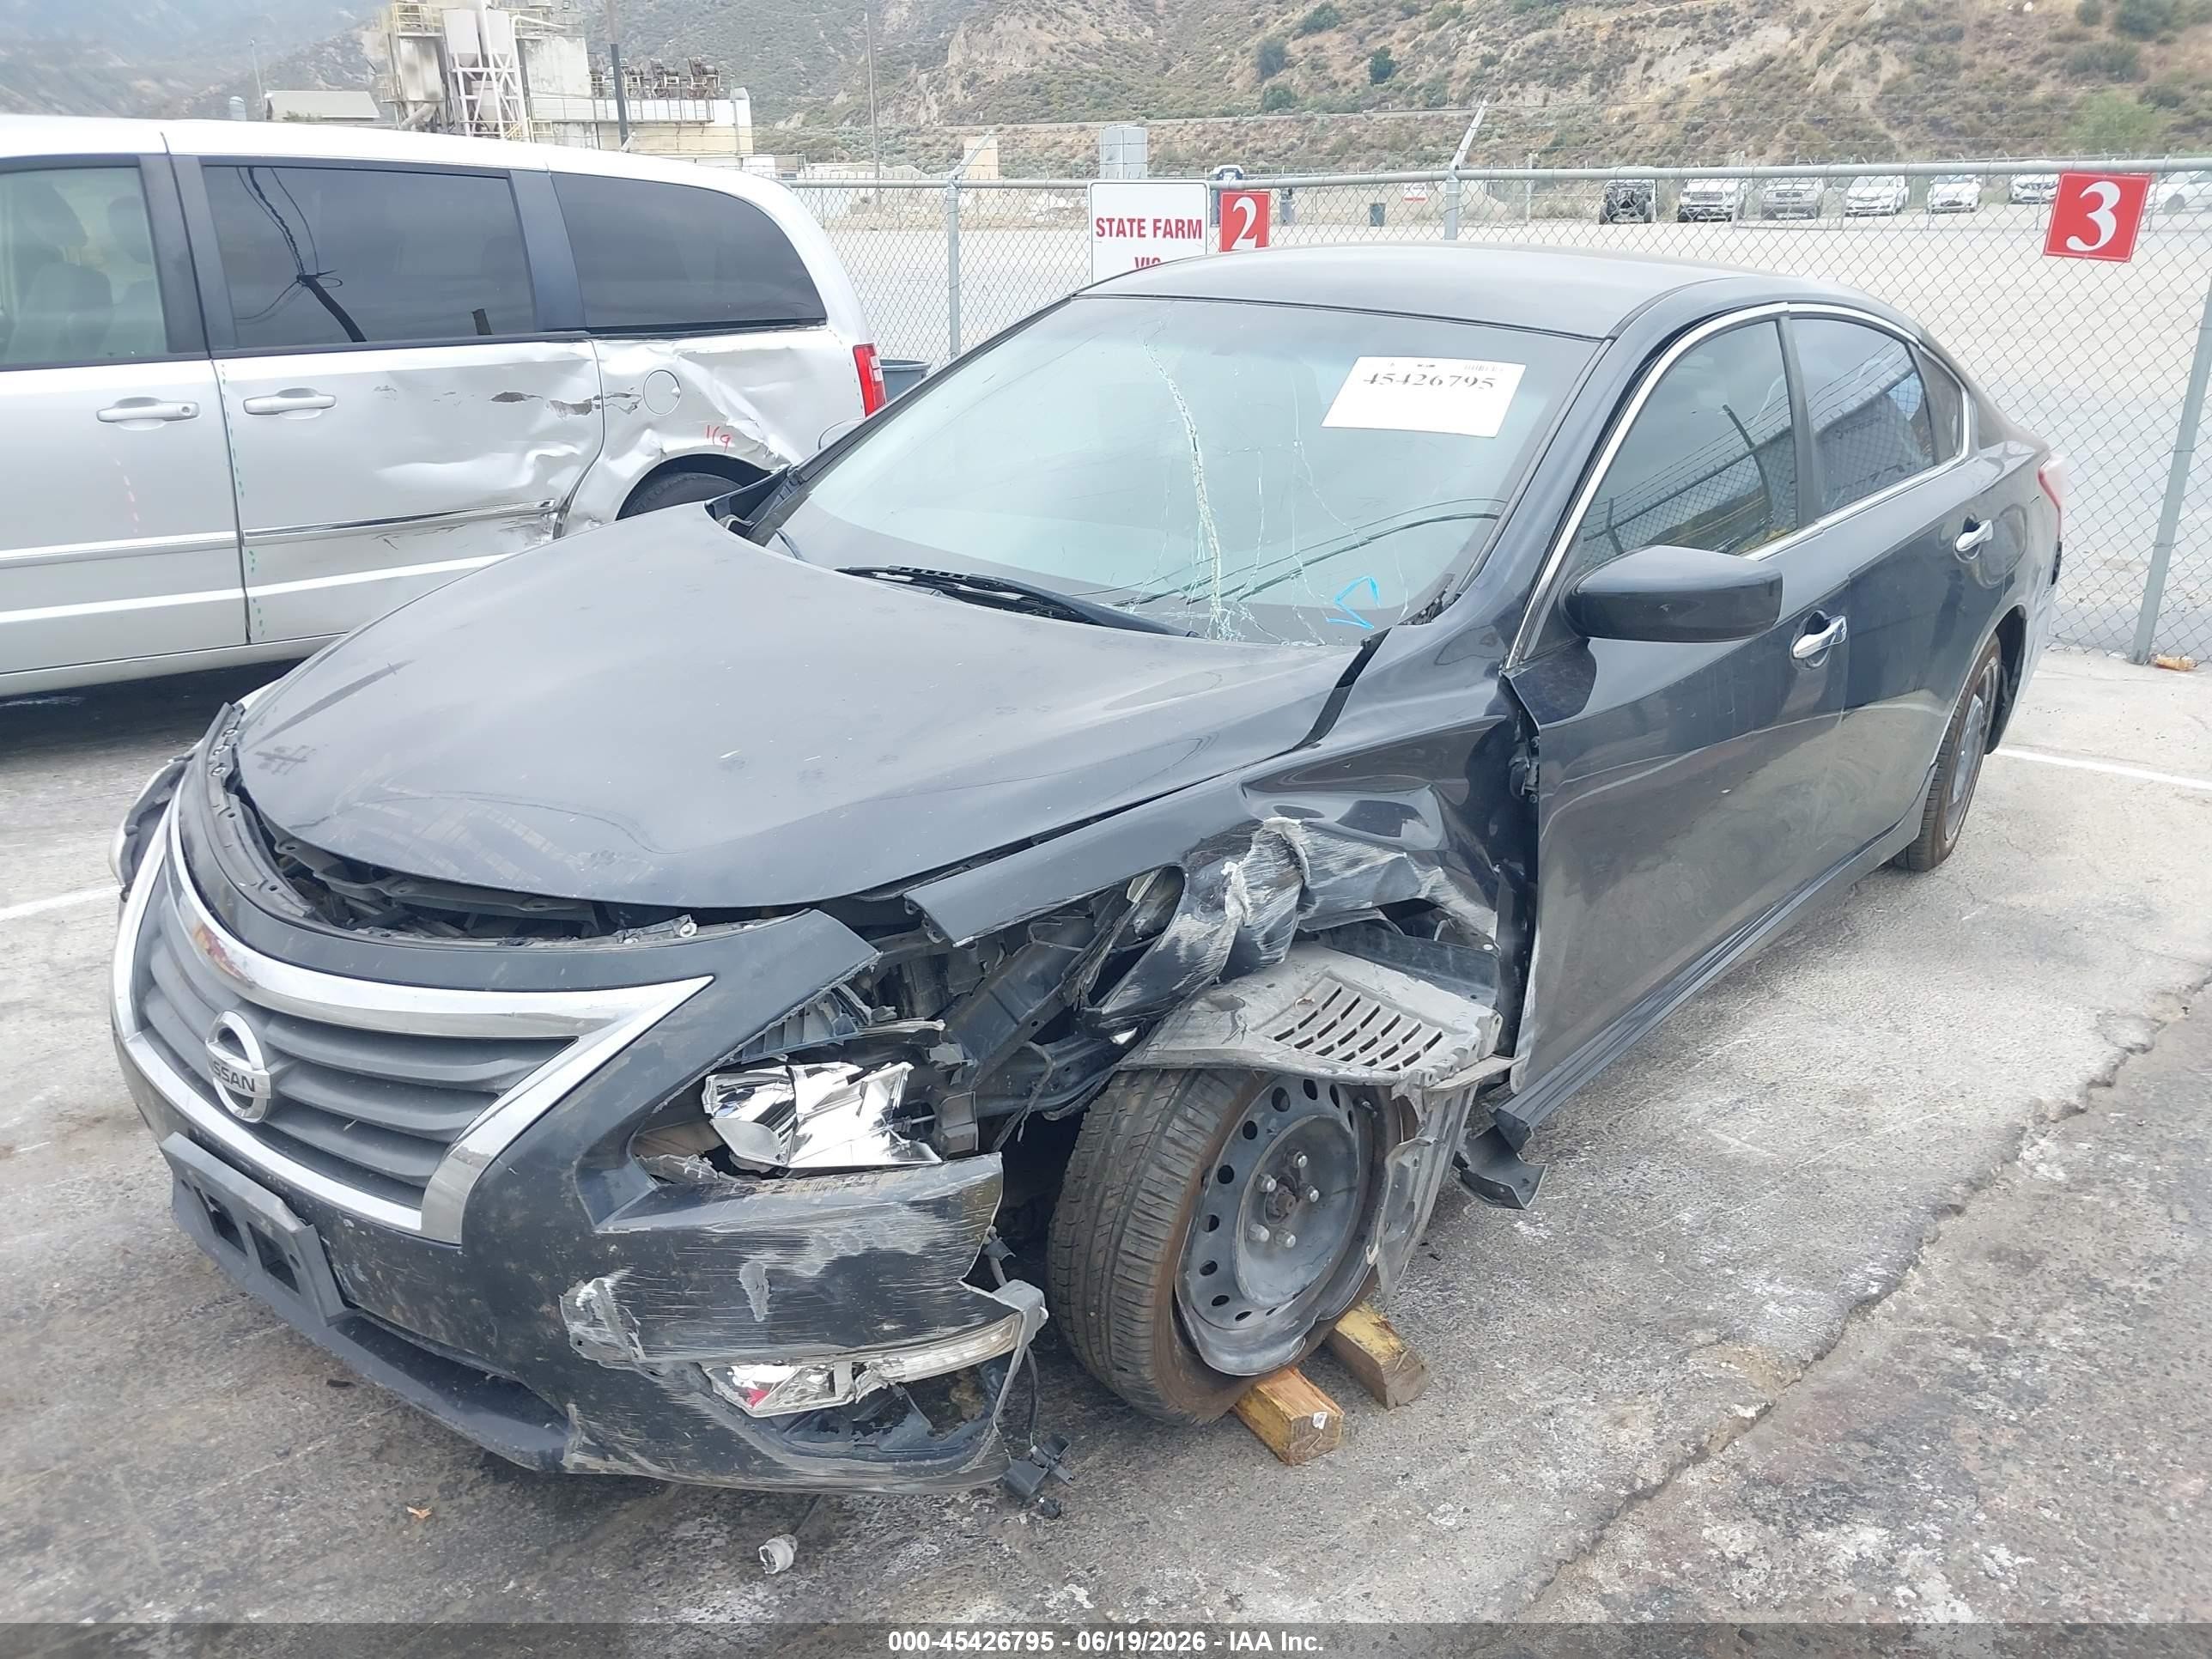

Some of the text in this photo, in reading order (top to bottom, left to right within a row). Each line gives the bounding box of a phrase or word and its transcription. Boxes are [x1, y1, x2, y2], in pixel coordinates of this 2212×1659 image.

[1096, 217, 1202, 239] STATE FARM
[1230, 196, 1258, 251] 2
[2065, 180, 2122, 252] 3
[1364, 373, 1498, 391] 45426795
[210, 1058, 256, 1093] SSAN
